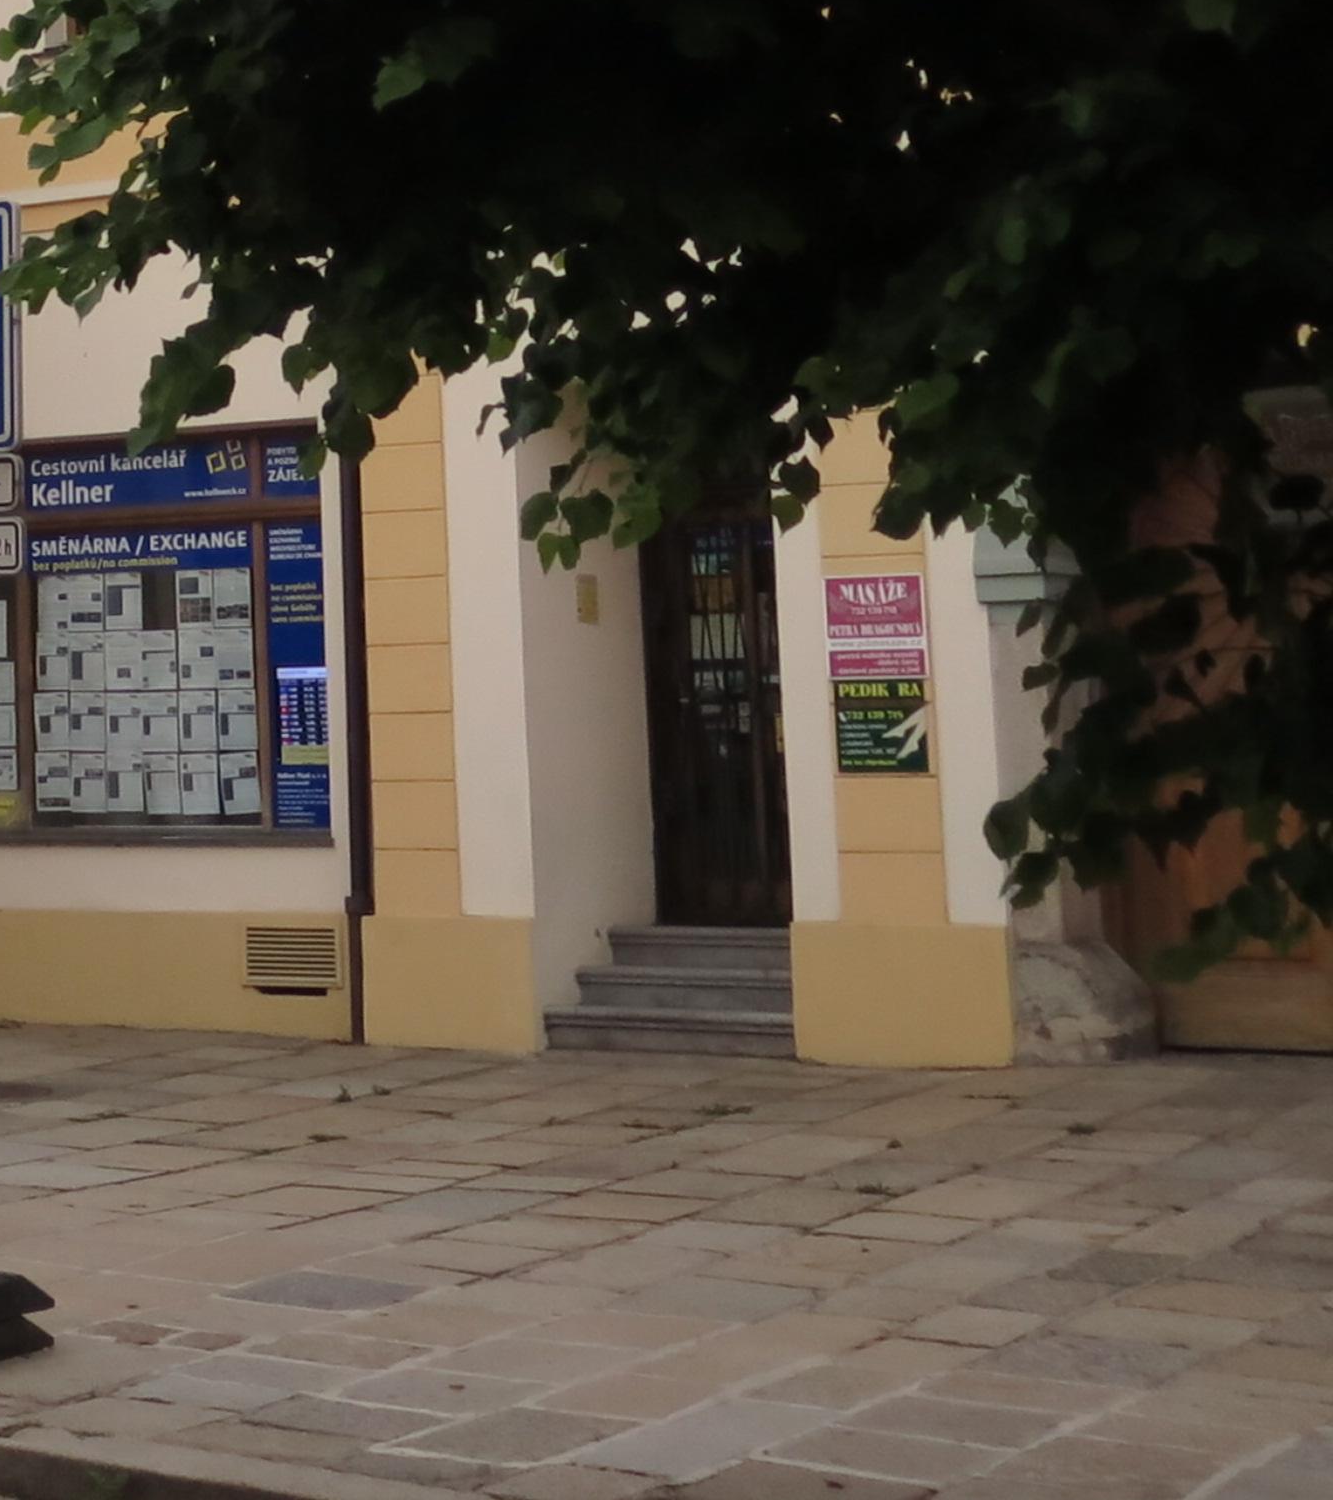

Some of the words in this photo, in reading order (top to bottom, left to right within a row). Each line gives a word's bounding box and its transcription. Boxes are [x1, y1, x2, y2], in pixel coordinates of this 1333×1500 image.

[30, 456, 106, 477] Cestovní
[110, 449, 188, 472] kancelář
[31, 479, 115, 507] Kellner
[31, 534, 131, 557] SMĚNÁRNA
[134, 535, 144, 555] /
[149, 530, 248, 551] EXCHANGE
[117, 555, 178, 568] commission
[839, 578, 907, 606] MASÁŽE
